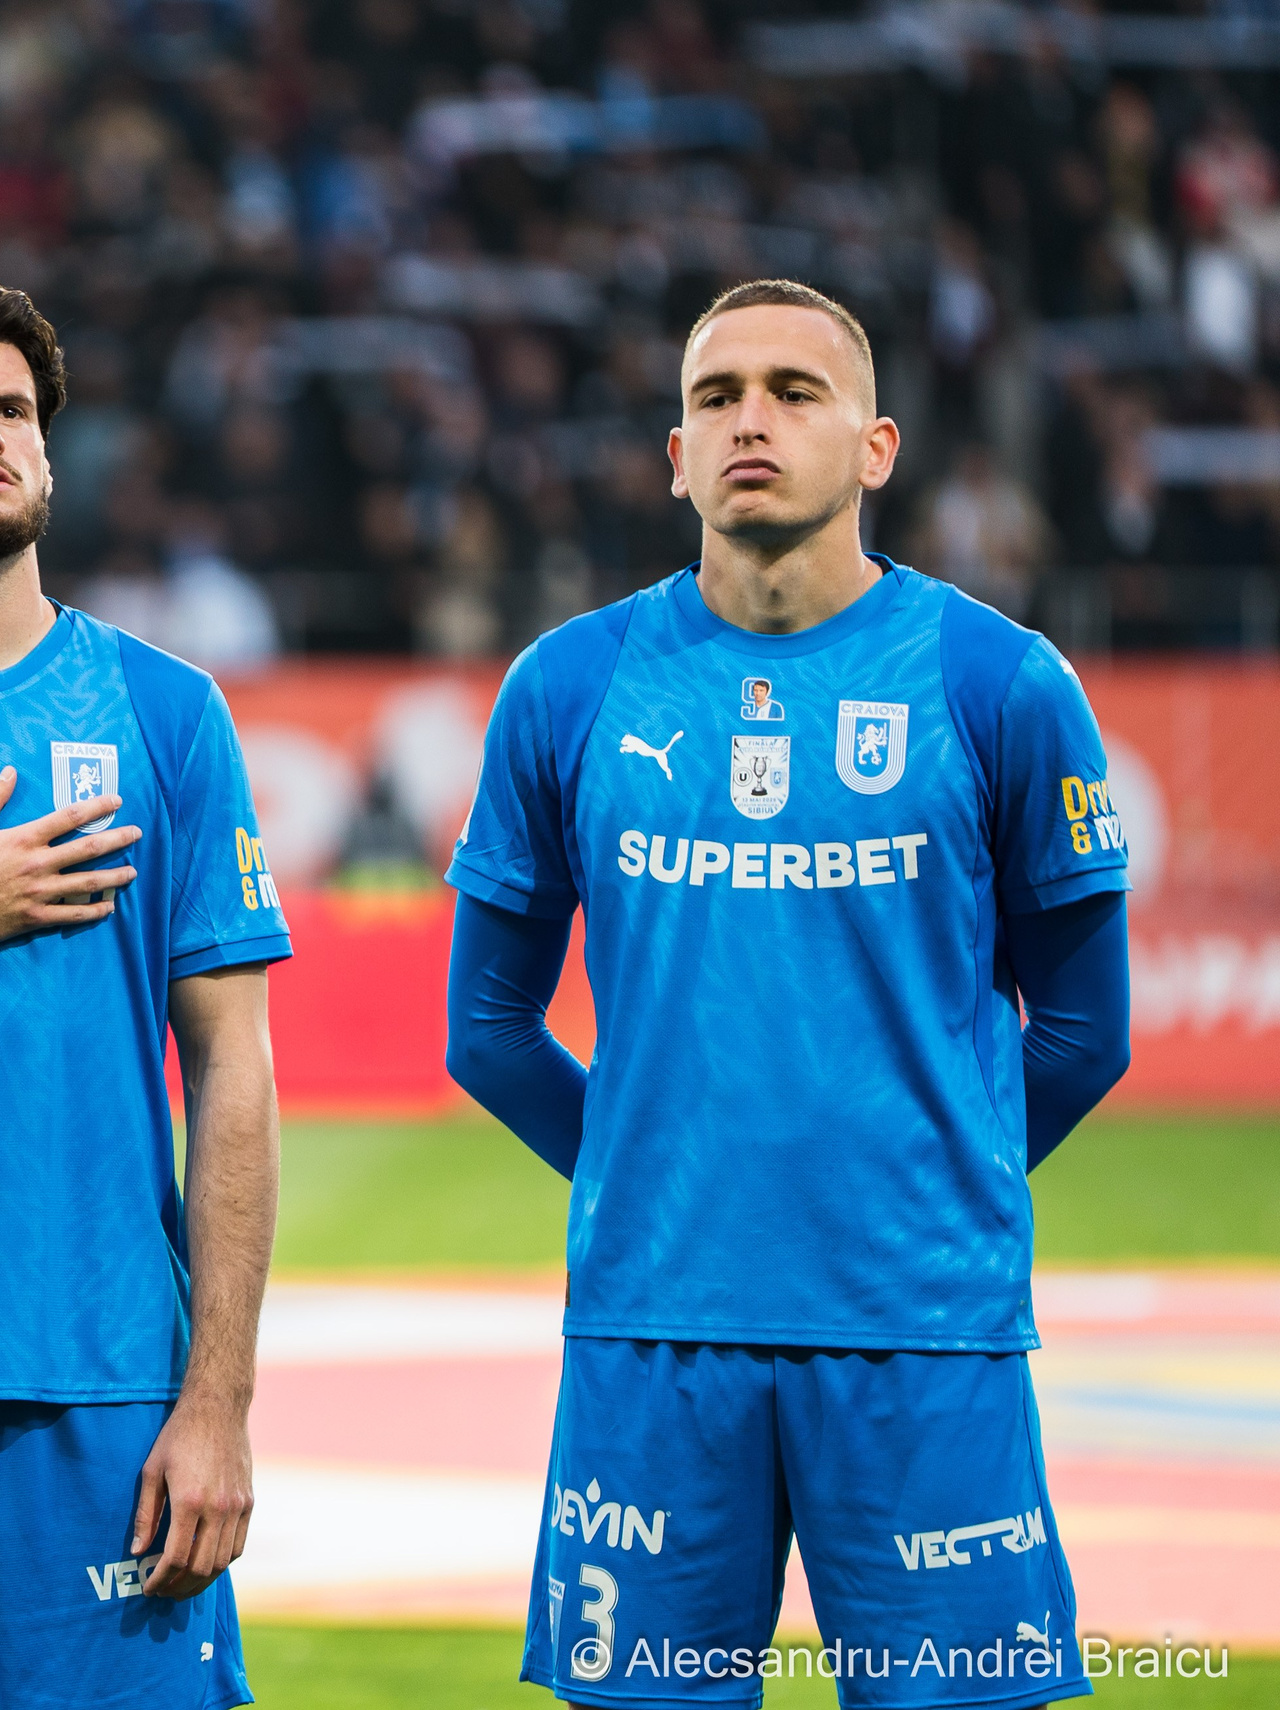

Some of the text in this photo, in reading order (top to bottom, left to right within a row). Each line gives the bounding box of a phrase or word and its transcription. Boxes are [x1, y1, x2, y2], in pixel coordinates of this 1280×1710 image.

[841, 702, 907, 717] CRAIOVA
[53, 744, 115, 757] CRAIOVA
[739, 773, 747, 781] U
[1070, 821, 1093, 854] &
[617, 829, 928, 889] SUPERBET
[241, 875, 259, 911] &
[551, 1478, 666, 1555] DEVIN
[893, 1506, 1047, 1571] VECTRUM
[571, 1563, 619, 1683] 3
